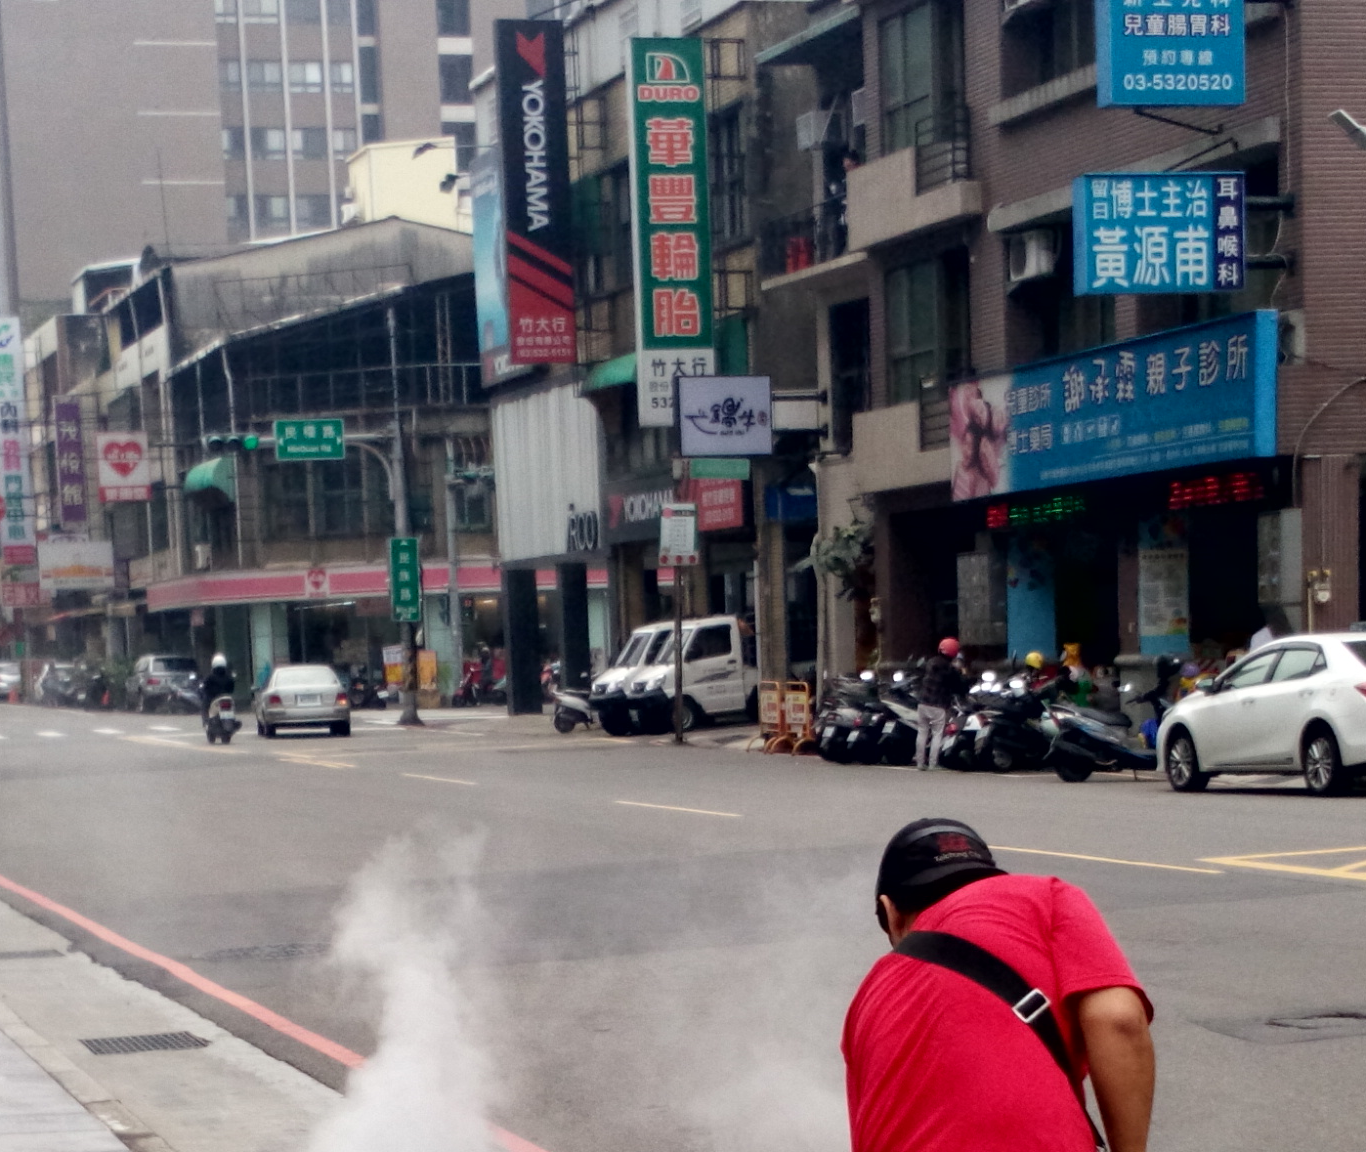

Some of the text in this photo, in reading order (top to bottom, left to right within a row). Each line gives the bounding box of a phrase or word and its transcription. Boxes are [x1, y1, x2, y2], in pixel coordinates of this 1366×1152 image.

[1124, 14, 1231, 37] 兒童腸胃科
[638, 85, 699, 102] DURO
[1123, 73, 1233, 91] 03-5320520
[521, 79, 549, 232] YOKOHAMA
[646, 117, 701, 337] 華豐輪胎
[1091, 225, 1210, 288] 黃源甫
[1217, 178, 1239, 286] 耳鼻喉科
